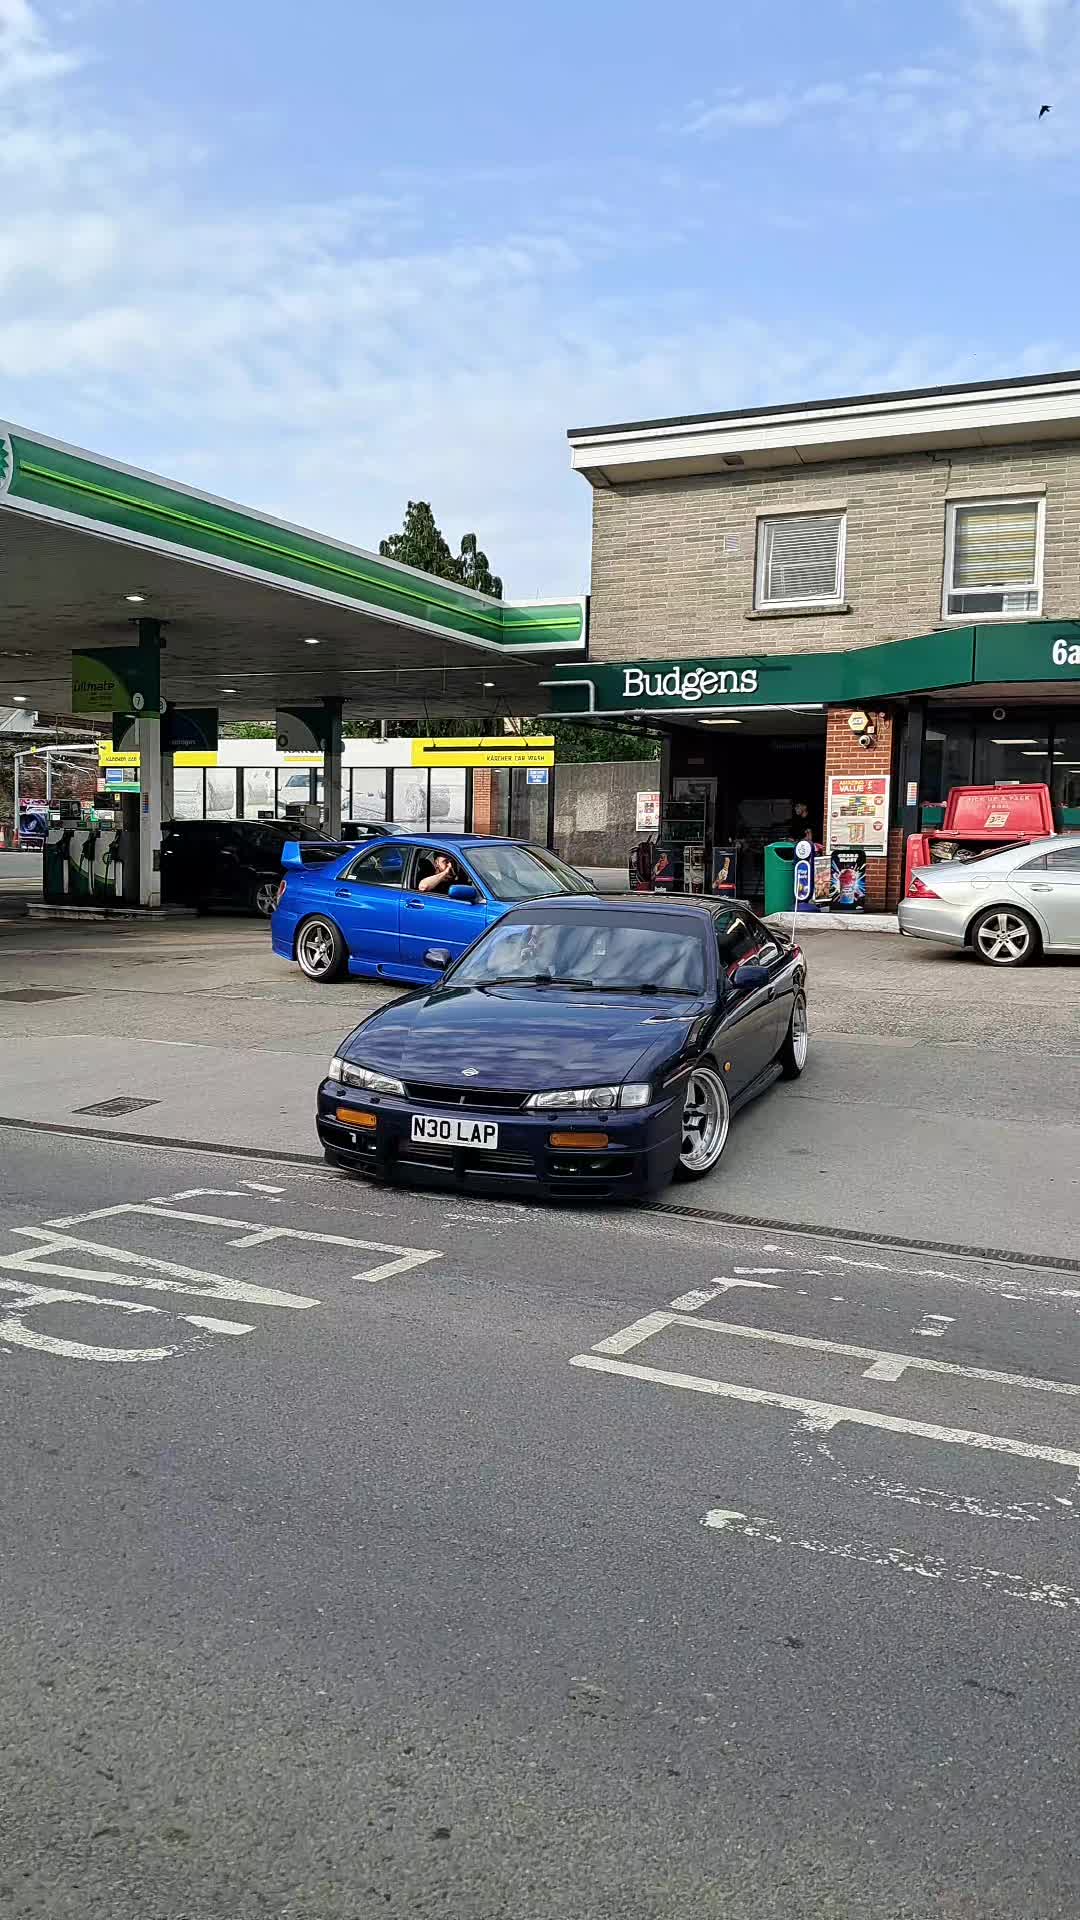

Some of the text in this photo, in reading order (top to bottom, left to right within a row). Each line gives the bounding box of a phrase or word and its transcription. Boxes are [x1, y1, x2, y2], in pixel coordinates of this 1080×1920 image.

[622, 666, 758, 701] Budgens
[839, 785, 865, 793] VALUE
[414, 1117, 496, 1144] N30 LAP
